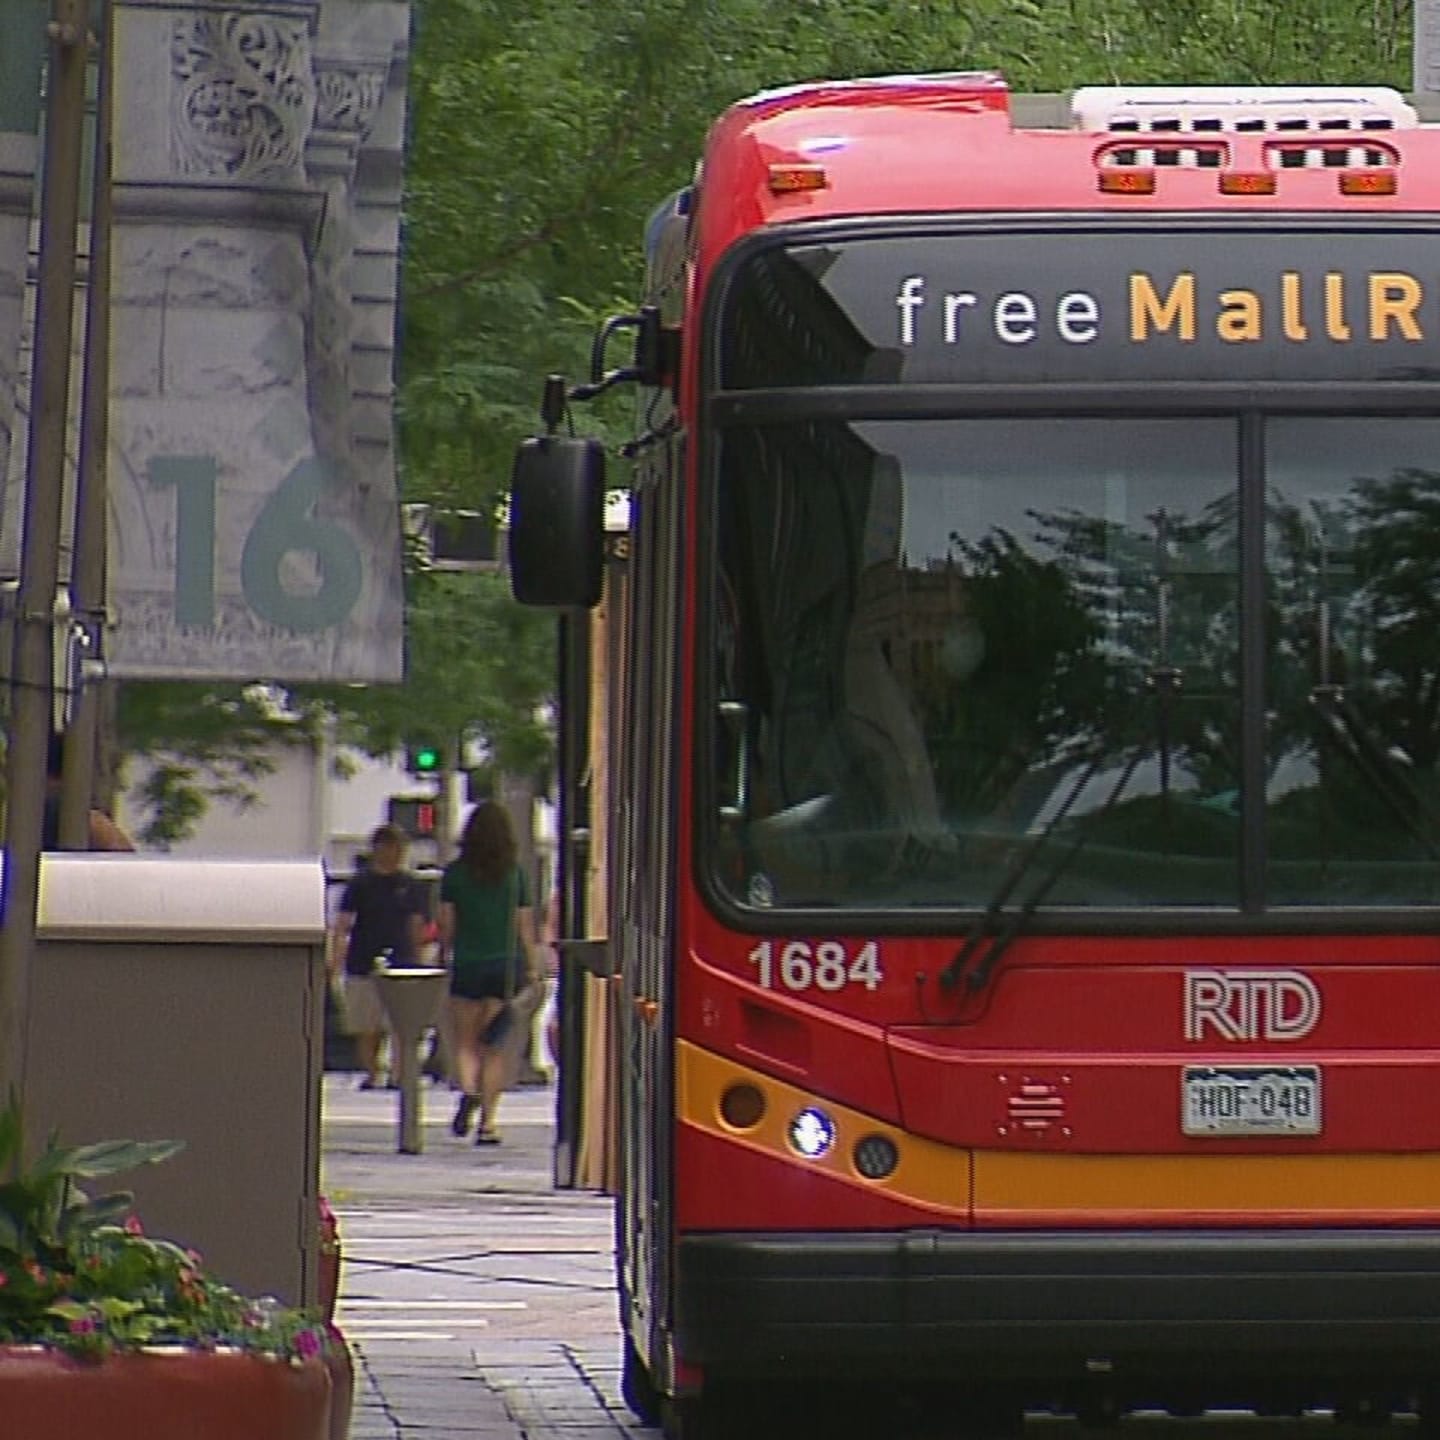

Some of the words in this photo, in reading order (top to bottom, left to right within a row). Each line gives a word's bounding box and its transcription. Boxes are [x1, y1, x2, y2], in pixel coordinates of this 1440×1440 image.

[896, 276, 1101, 344] free
[147, 455, 363, 632] 16
[748, 940, 884, 991] 1684
[1183, 970, 1322, 1042] RTD
